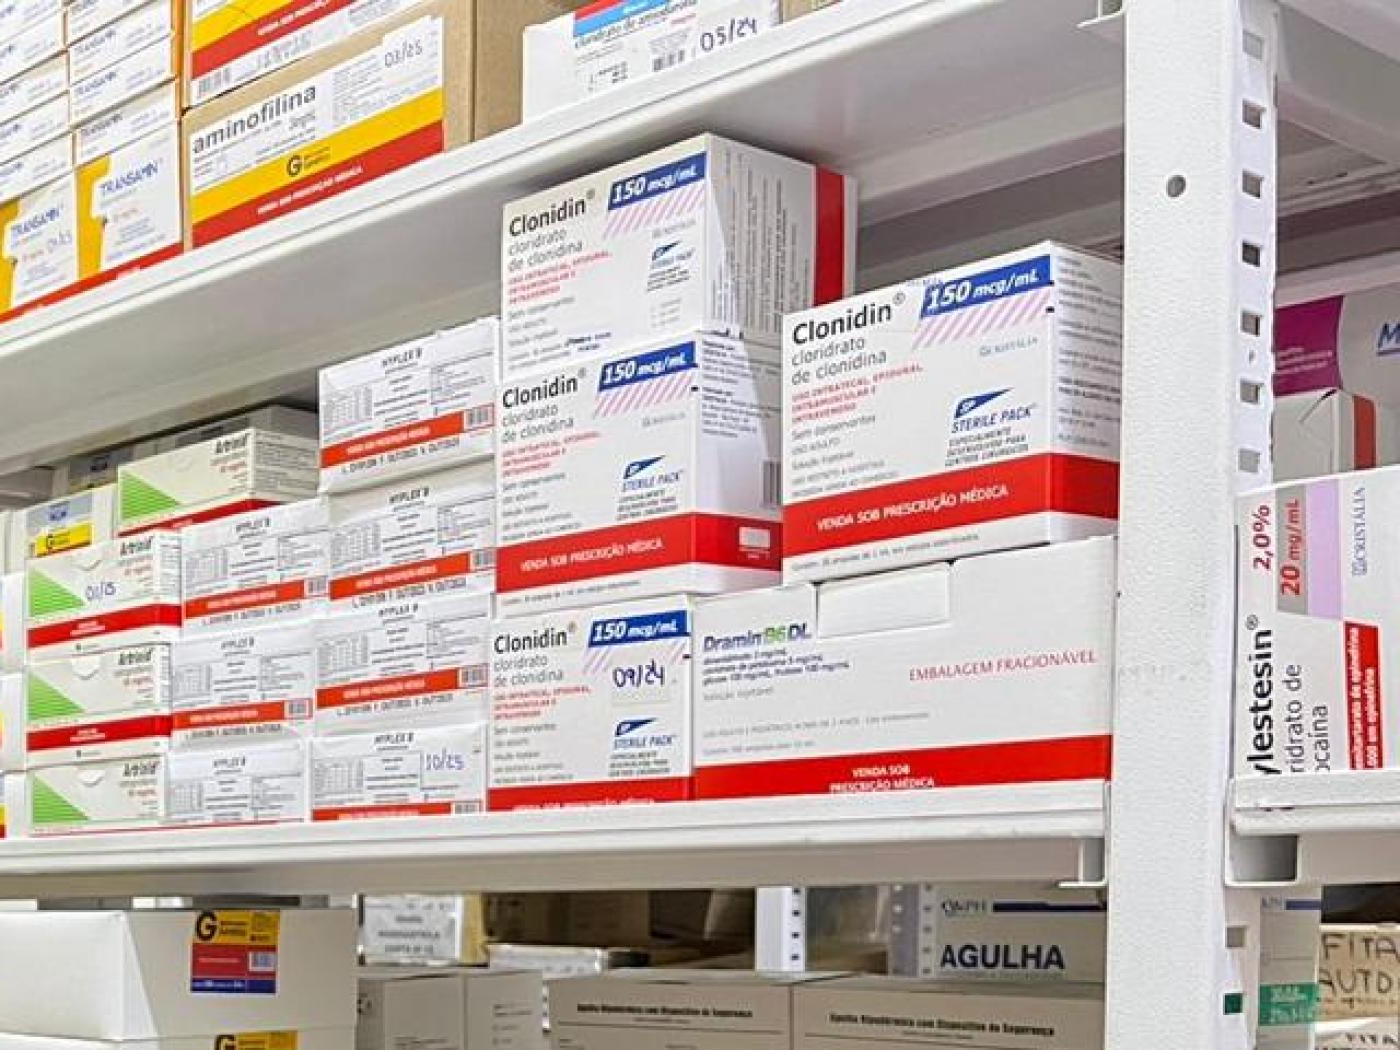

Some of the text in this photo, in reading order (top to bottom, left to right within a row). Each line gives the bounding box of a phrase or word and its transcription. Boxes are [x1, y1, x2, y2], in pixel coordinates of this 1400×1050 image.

[700, 17, 758, 51] 05/24
[193, 84, 316, 155] aminofilina
[286, 154, 302, 178] G
[612, 177, 647, 203] 150
[925, 268, 1041, 311] 150 mcg/mL
[791, 337, 865, 368] cloridrato
[602, 360, 637, 385] 150
[791, 352, 887, 386] de clonidina
[951, 408, 1032, 434] STERILE PACK
[816, 512, 854, 531] VENDA
[856, 506, 881, 524] SOB
[959, 483, 1010, 505] MÉDICA
[1252, 503, 1274, 572] 2,0%
[1279, 498, 1306, 597] 20 mg/mL
[592, 622, 627, 643] 150
[612, 658, 666, 689] 09/24
[909, 648, 1098, 682] EMBALAGEM FRACIONÁVEL
[1281, 663, 1302, 692] de
[852, 764, 911, 778] VENDA SOB
[196, 911, 218, 942] G
[939, 943, 1066, 971] AGULHA
[1320, 932, 1400, 963] FITA
[1318, 968, 1400, 997] AUTO
